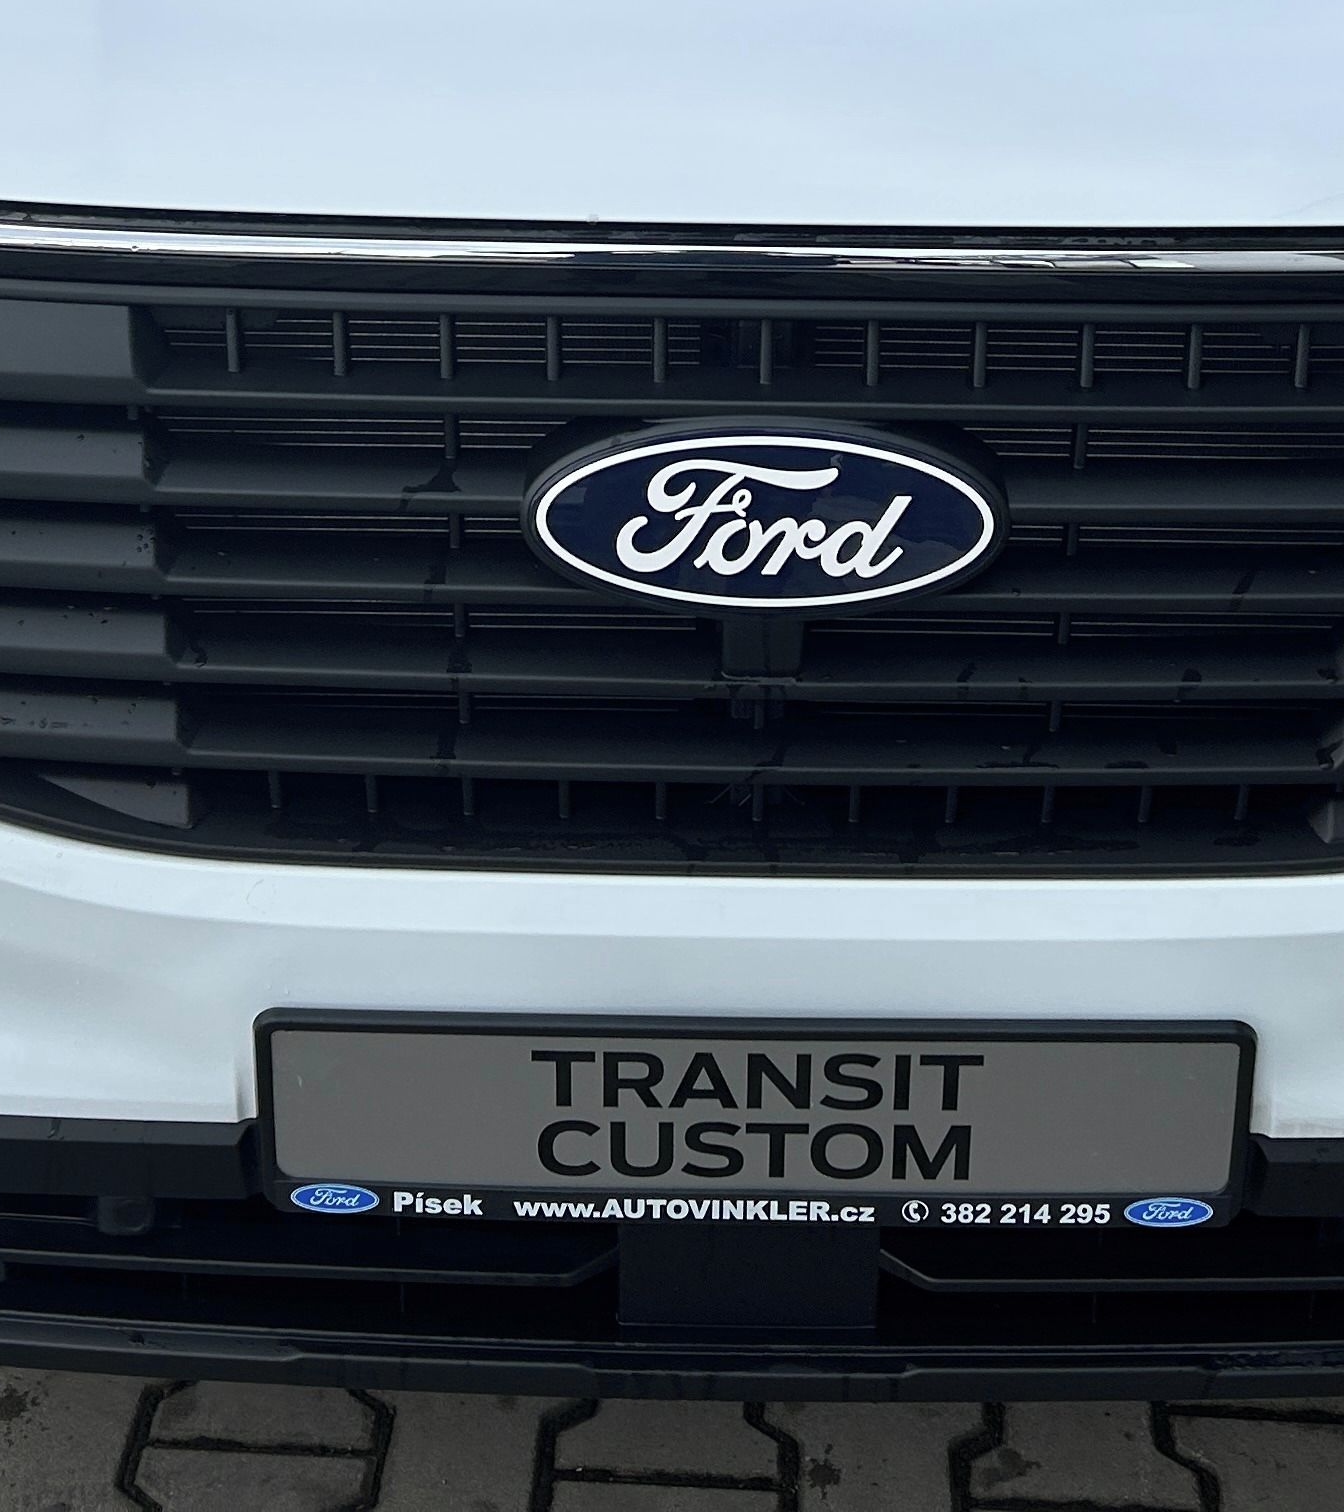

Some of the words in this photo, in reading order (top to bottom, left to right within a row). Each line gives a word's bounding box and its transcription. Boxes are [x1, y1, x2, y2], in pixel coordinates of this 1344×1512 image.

[616, 459, 912, 578] Ford
[531, 1050, 984, 1112] TRANSIT
[536, 1120, 972, 1181] CUSTOM
[310, 1188, 359, 1207] Ford
[393, 1191, 484, 1215] Písek
[513, 1198, 875, 1222] www.AUTOVINKLER.cz
[941, 1203, 991, 1224] 382
[999, 1203, 1051, 1224] 214
[1059, 1204, 1110, 1224] 295
[1143, 1202, 1192, 1221] Ford
